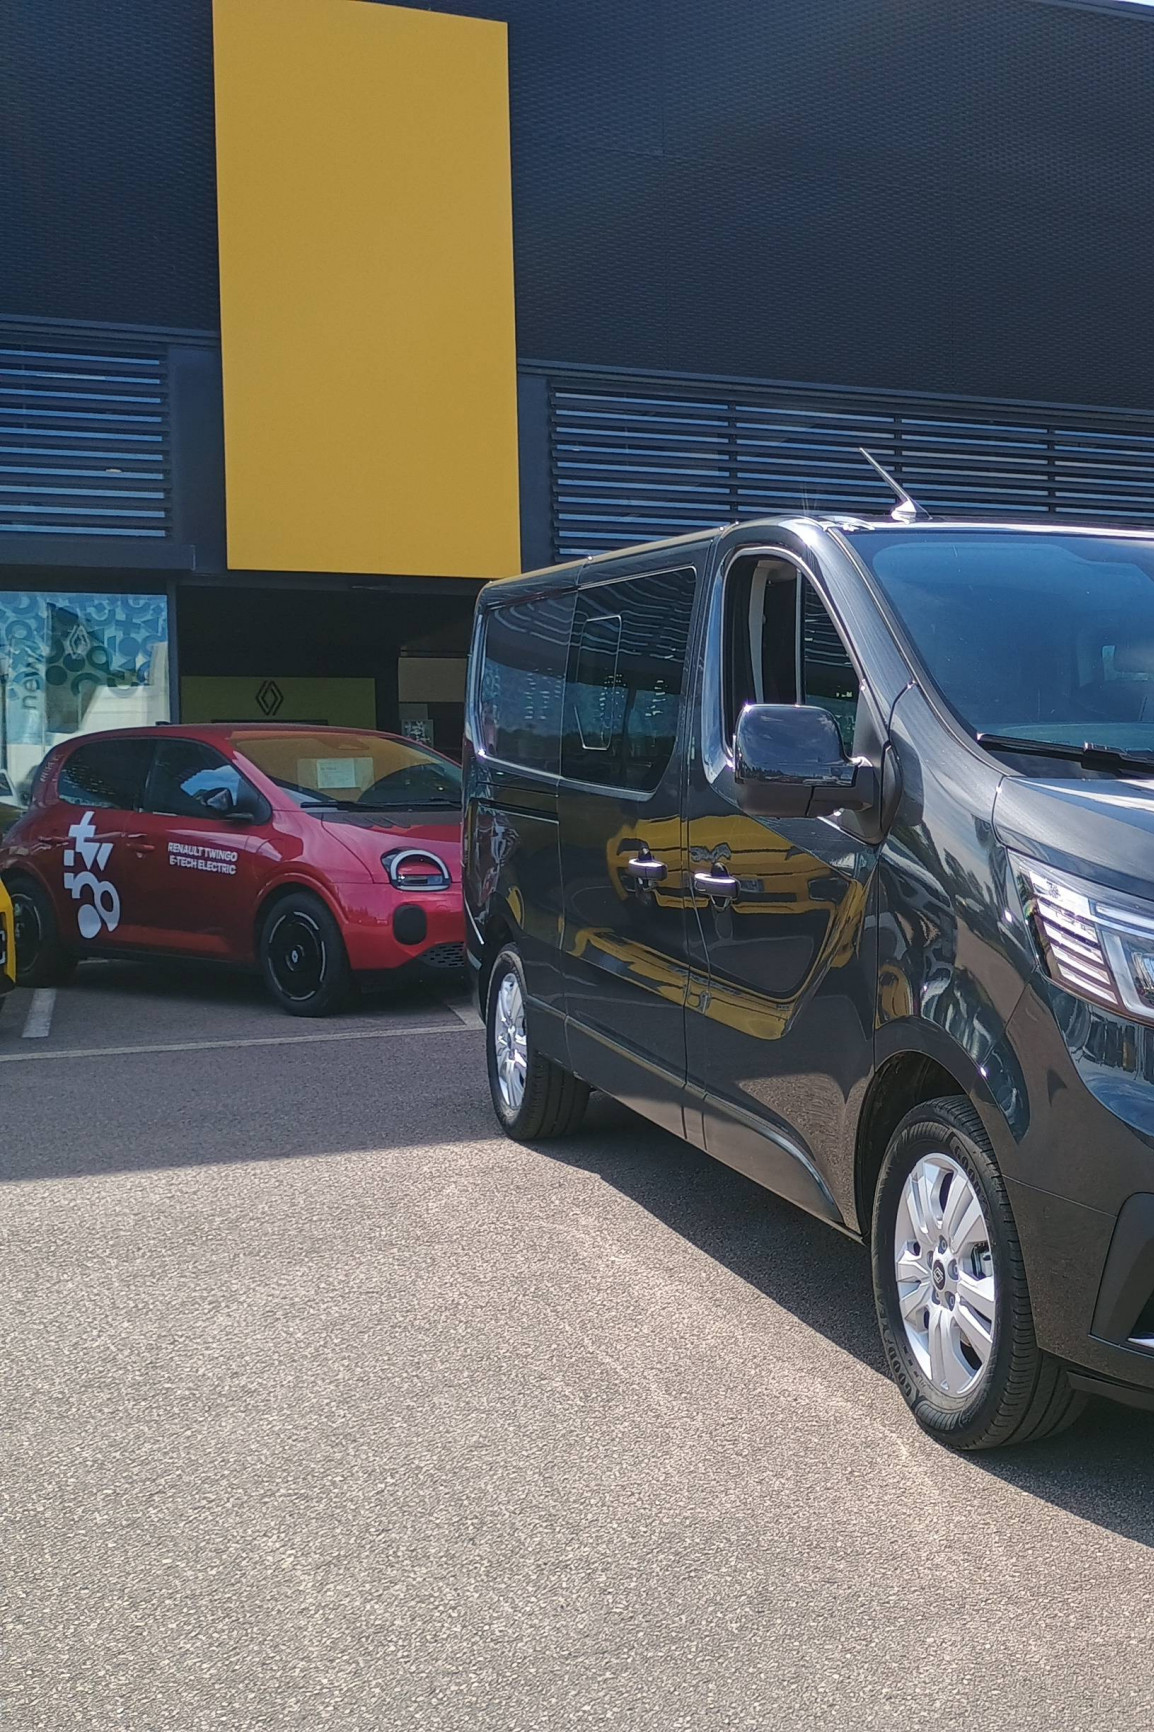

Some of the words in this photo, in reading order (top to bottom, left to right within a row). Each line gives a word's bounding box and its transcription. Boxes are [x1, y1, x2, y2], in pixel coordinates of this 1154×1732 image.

[168, 842, 203, 857] RENAULT
[203, 847, 238, 862] TWINGO
[169, 855, 198, 869] E-TECH
[198, 860, 237, 875] ELECTRIC
